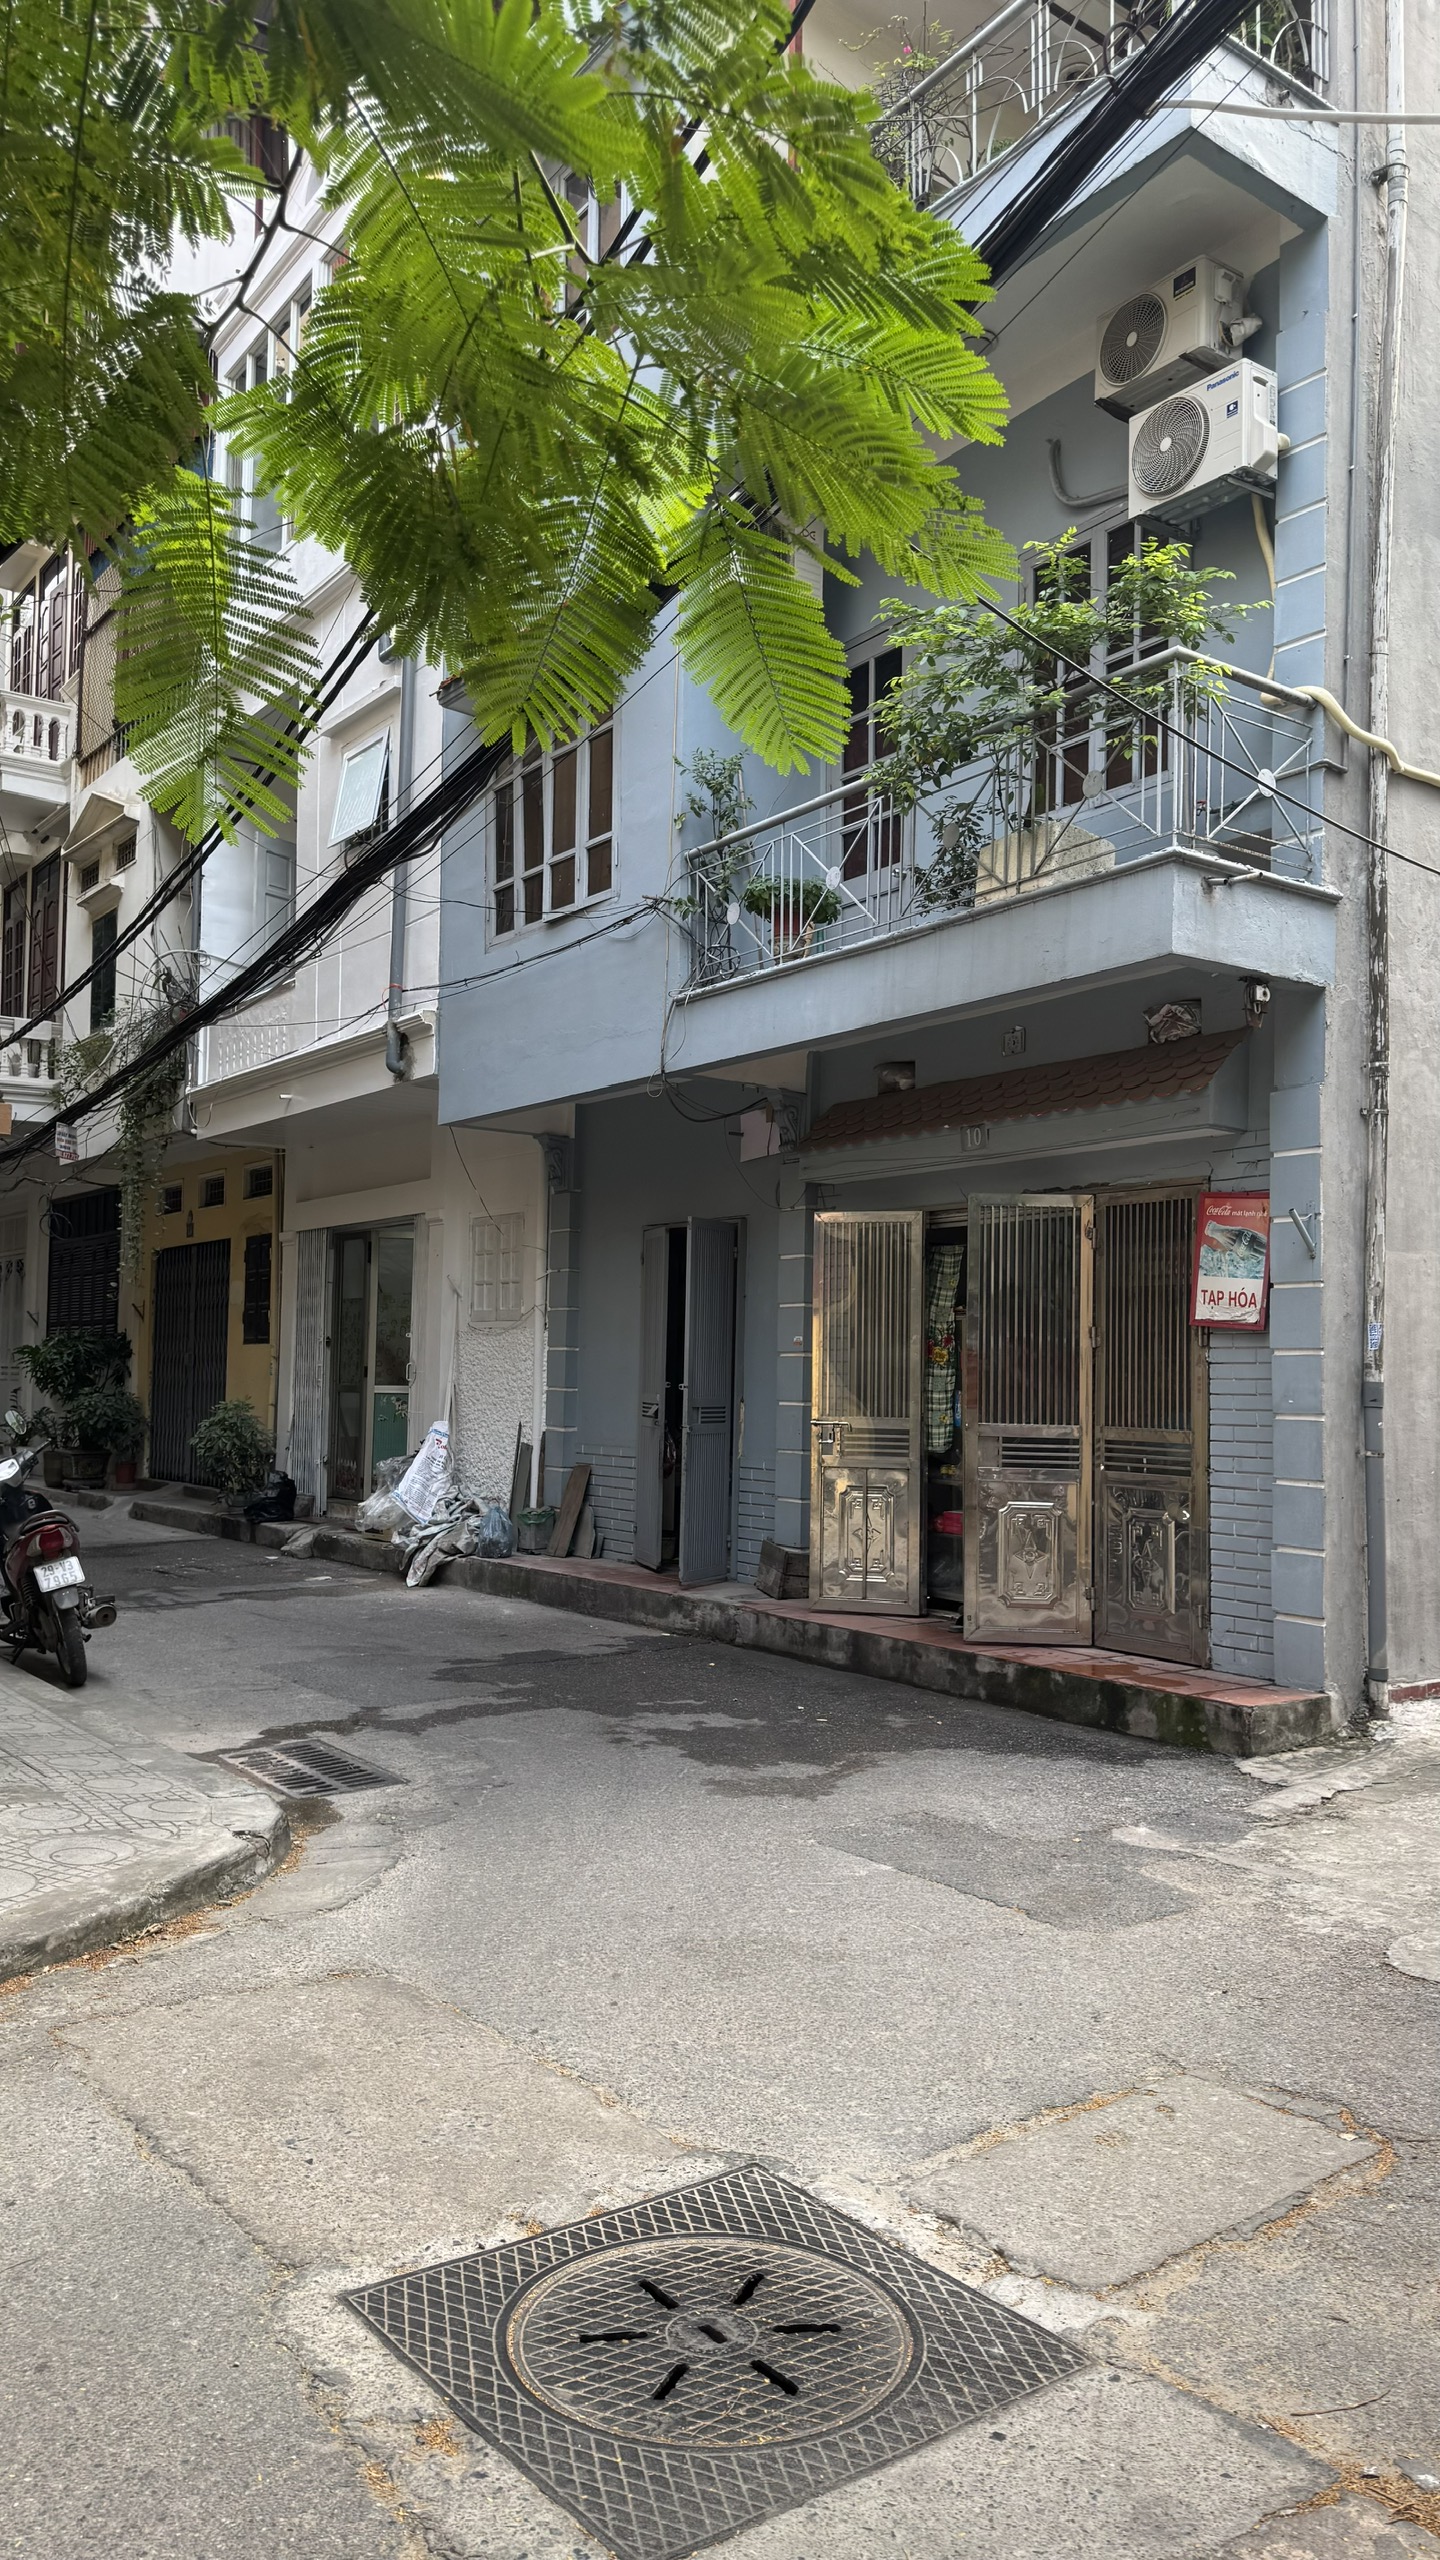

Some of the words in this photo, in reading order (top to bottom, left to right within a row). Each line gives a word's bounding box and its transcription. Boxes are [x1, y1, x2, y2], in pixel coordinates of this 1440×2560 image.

[1206, 370, 1240, 392] Panasonic
[966, 1127, 982, 1147] 10
[1201, 1289, 1225, 1309] TẠP
[1228, 1287, 1257, 1309] HÓA
[41, 1560, 74, 1578] 29-V3
[44, 1571, 78, 1589] 7965
